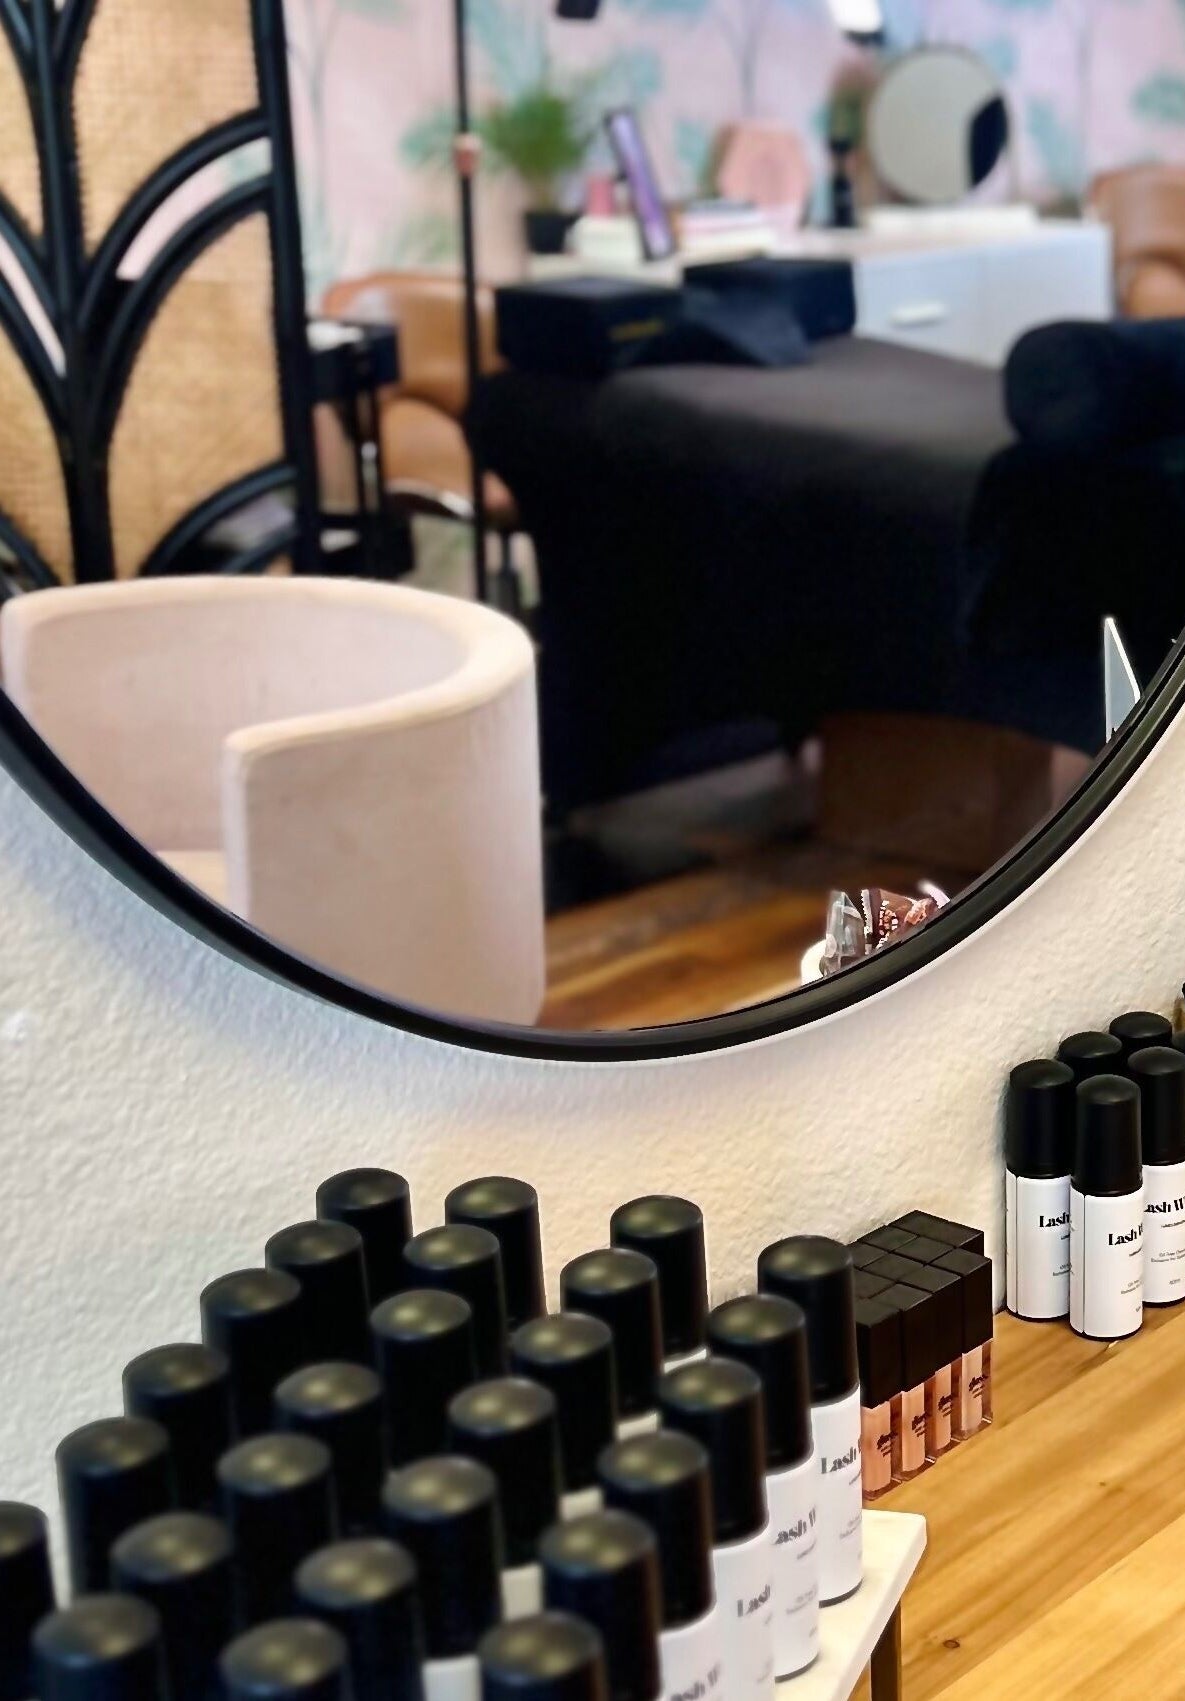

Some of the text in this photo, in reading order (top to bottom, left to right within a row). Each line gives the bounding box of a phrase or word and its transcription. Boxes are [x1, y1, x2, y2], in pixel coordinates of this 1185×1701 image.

[1143, 1201, 1172, 1214] ash
[1108, 1228, 1138, 1246] Lash
[820, 1446, 857, 1475] Lash
[773, 1519, 807, 1546] ash
